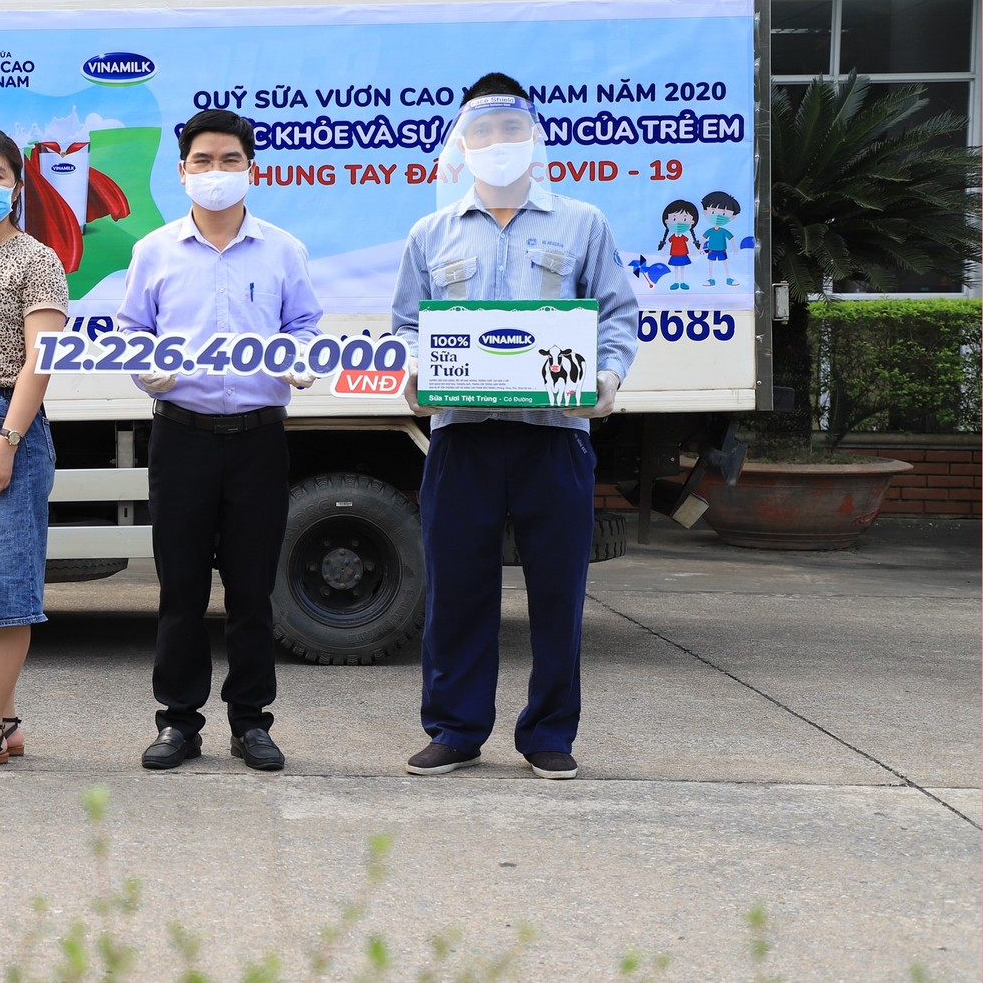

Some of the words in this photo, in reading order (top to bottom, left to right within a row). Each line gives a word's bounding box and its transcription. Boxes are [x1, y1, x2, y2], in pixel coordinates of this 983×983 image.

[87, 60, 152, 75] VINAMILK
[193, 85, 248, 110] QUỸ
[254, 84, 308, 109] SỮA
[316, 84, 391, 108] VƯƠN
[399, 86, 454, 107] CAO
[530, 84, 587, 104] NAM
[597, 78, 656, 103] NĂM
[665, 81, 726, 102] 2020
[273, 119, 351, 147] KHỎE
[354, 119, 395, 146] VÀ
[400, 118, 442, 151] SỰ
[576, 115, 633, 143] CỦA
[641, 114, 697, 142] TRẺ
[702, 117, 741, 141] EM
[253, 165, 336, 186] HUNG
[344, 164, 397, 185] TAY
[529, 160, 618, 184] COVID
[650, 159, 683, 181] 19
[432, 335, 469, 347] 100%
[481, 333, 533, 345] VINAMILK
[38, 336, 407, 374] 12.226.400.000
[430, 350, 458, 363] Sữa
[430, 362, 470, 377] Tươi
[346, 374, 397, 391] VNĐ
